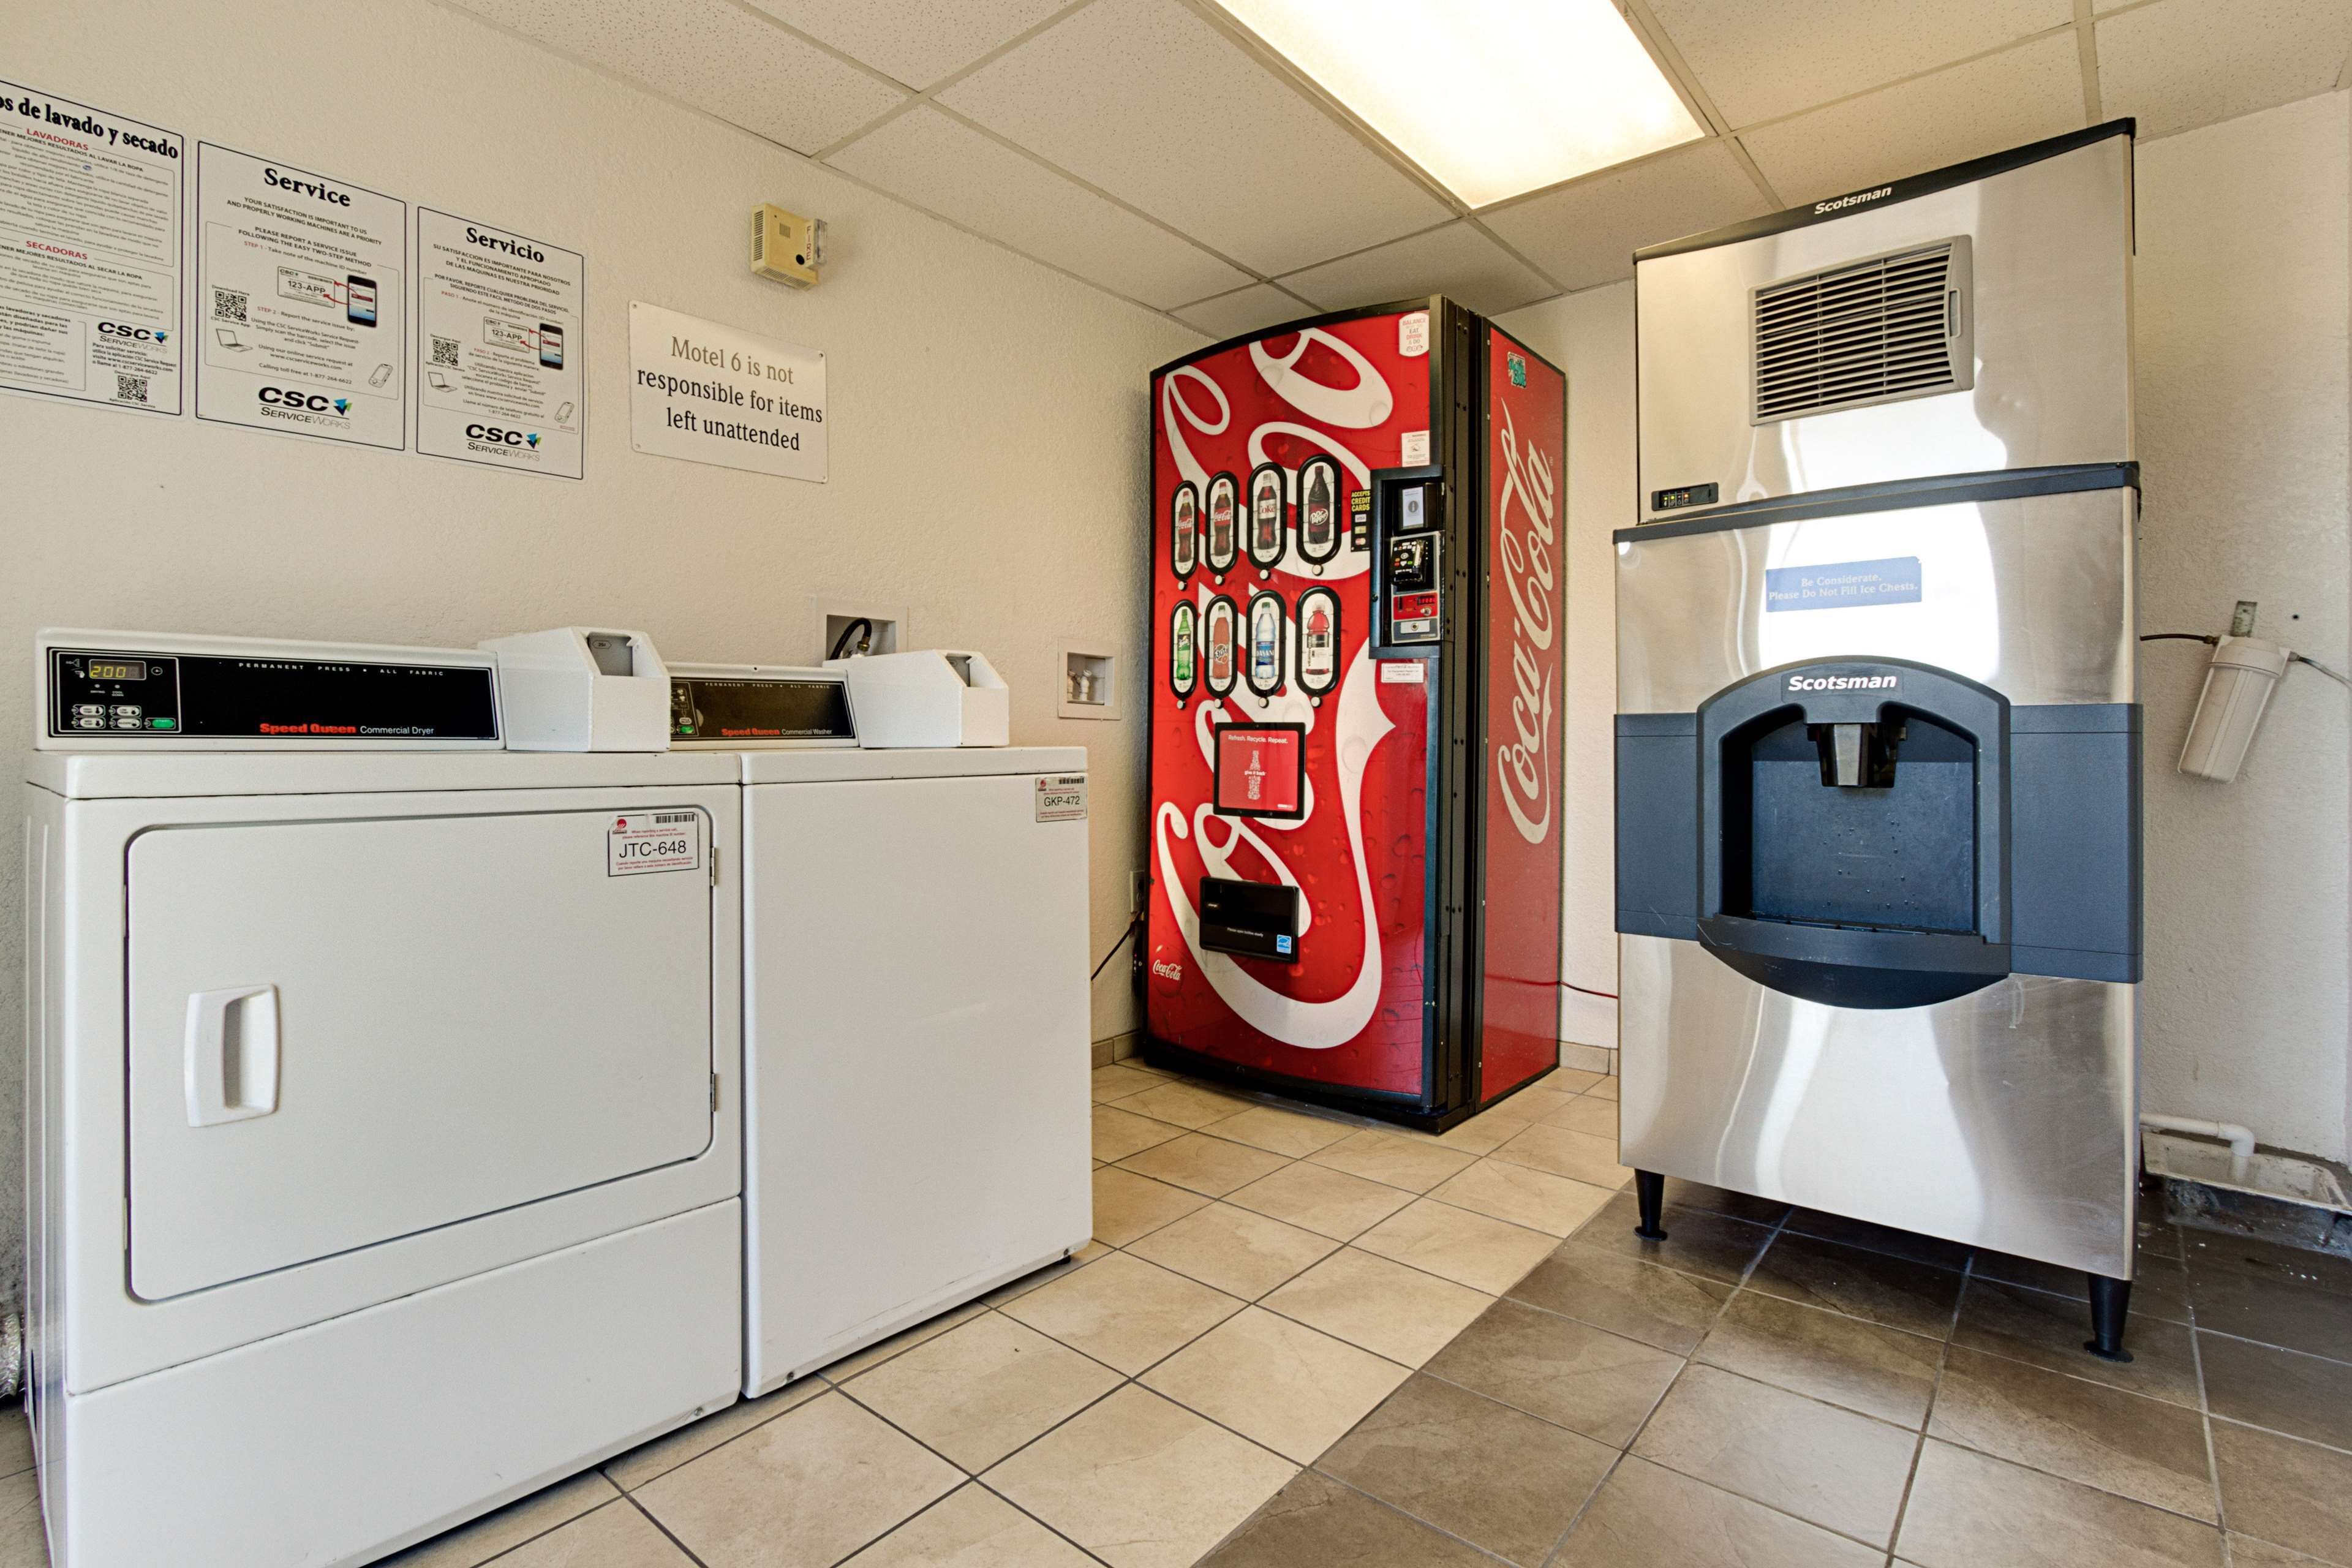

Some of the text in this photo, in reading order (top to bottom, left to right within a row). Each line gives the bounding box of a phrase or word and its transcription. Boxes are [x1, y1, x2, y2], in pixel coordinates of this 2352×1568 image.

[18, 97, 178, 159] de lavado y secado
[26, 128, 89, 151] LAVADORAS
[17, 133, 143, 172] MEJORES RESULTADOS LAVAR ROPA
[263, 167, 351, 207] Service
[1814, 186, 1893, 215] Scotsman
[243, 203, 275, 216] PROPERLY
[276, 213, 306, 225] WORKING
[307, 221, 337, 234] MACHINES
[356, 234, 382, 245] PRIORITY
[244, 197, 263, 206] YOUR
[263, 202, 307, 218] SATISFACTION
[315, 216, 349, 230] IMPORTANT
[26, 241, 88, 260] SECADORAS
[238, 229, 279, 244] FOLLOWING
[312, 247, 344, 260] TWO-STEP
[345, 256, 372, 268] METHOD
[255, 227, 279, 237] PLEASE
[281, 233, 306, 244] REPORT
[313, 241, 339, 252] SERVICE
[339, 248, 357, 257] ISSUE
[466, 227, 545, 263] Servicio
[16, 248, 45, 258] MEJORES
[47, 255, 87, 268] RESULTADOS
[97, 266, 116, 274] SECAR
[314, 258, 338, 268] machine
[442, 246, 483, 262] SATISFACCION
[491, 260, 527, 274] IMPORTANTE
[543, 274, 571, 286] NOSOTROS
[467, 266, 497, 279] MAQUINAS
[505, 277, 530, 288] NUESTRA
[531, 284, 560, 295] PRIORIDAD
[469, 260, 551, 287] FUNCIONAMIENTO APROPIADO
[288, 280, 326, 294] 123-APP
[98, 322, 151, 341] CSC
[251, 317, 266, 326] Using
[492, 328, 522, 341] 123-APP
[326, 357, 347, 366] request
[671, 336, 794, 385] Motel 6 is not
[258, 363, 279, 372] Calling
[309, 372, 352, 385] 1-877-264-6622
[258, 386, 330, 412] CSC
[637, 368, 823, 424] responsible for items
[466, 424, 523, 446] CSC
[666, 407, 801, 451] left unattended
[1768, 581, 1918, 601] Please Do Not Fill Ice Chests.
[1801, 573, 1882, 587] Be Considerate.
[238, 662, 305, 671] PERMANENT
[1789, 675, 1897, 692] Scotsman
[259, 723, 435, 737] Speed Queen Commercial Dryer
[721, 728, 751, 737] Speed
[1044, 795, 1080, 807] GKP-472
[619, 840, 687, 858] JTC-648
